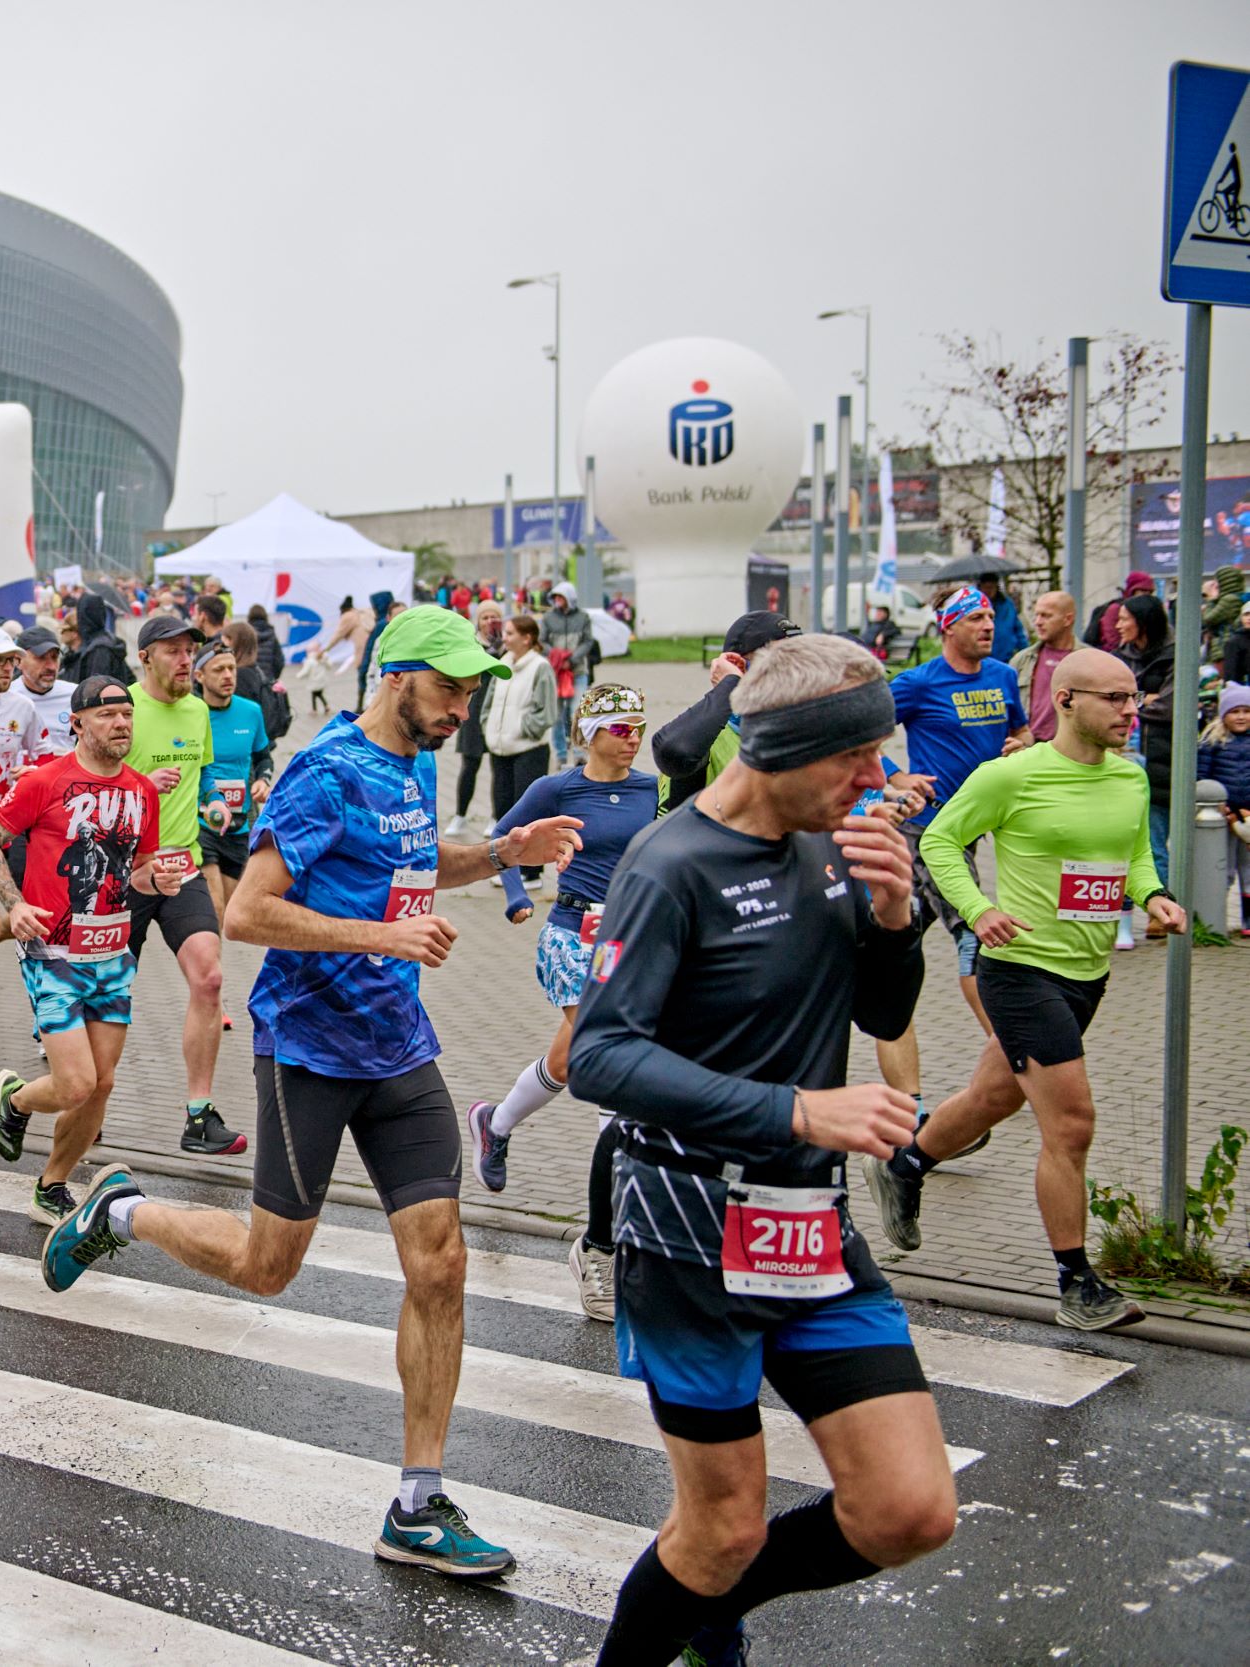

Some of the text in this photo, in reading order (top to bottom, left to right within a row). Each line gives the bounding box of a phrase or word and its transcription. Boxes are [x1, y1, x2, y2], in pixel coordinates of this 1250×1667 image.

[648, 484, 754, 505] Bank Polski
[951, 688, 1004, 706] GLIWICE
[152, 754, 171, 763] TEAM
[65, 787, 143, 839] RUN
[1073, 879, 1121, 901] 2616
[396, 894, 432, 919] 249
[1088, 903, 1110, 911] JAKUB
[81, 926, 122, 946] 2671
[748, 1217, 824, 1256] 2116
[754, 1259, 818, 1275] MIROSŁAW
